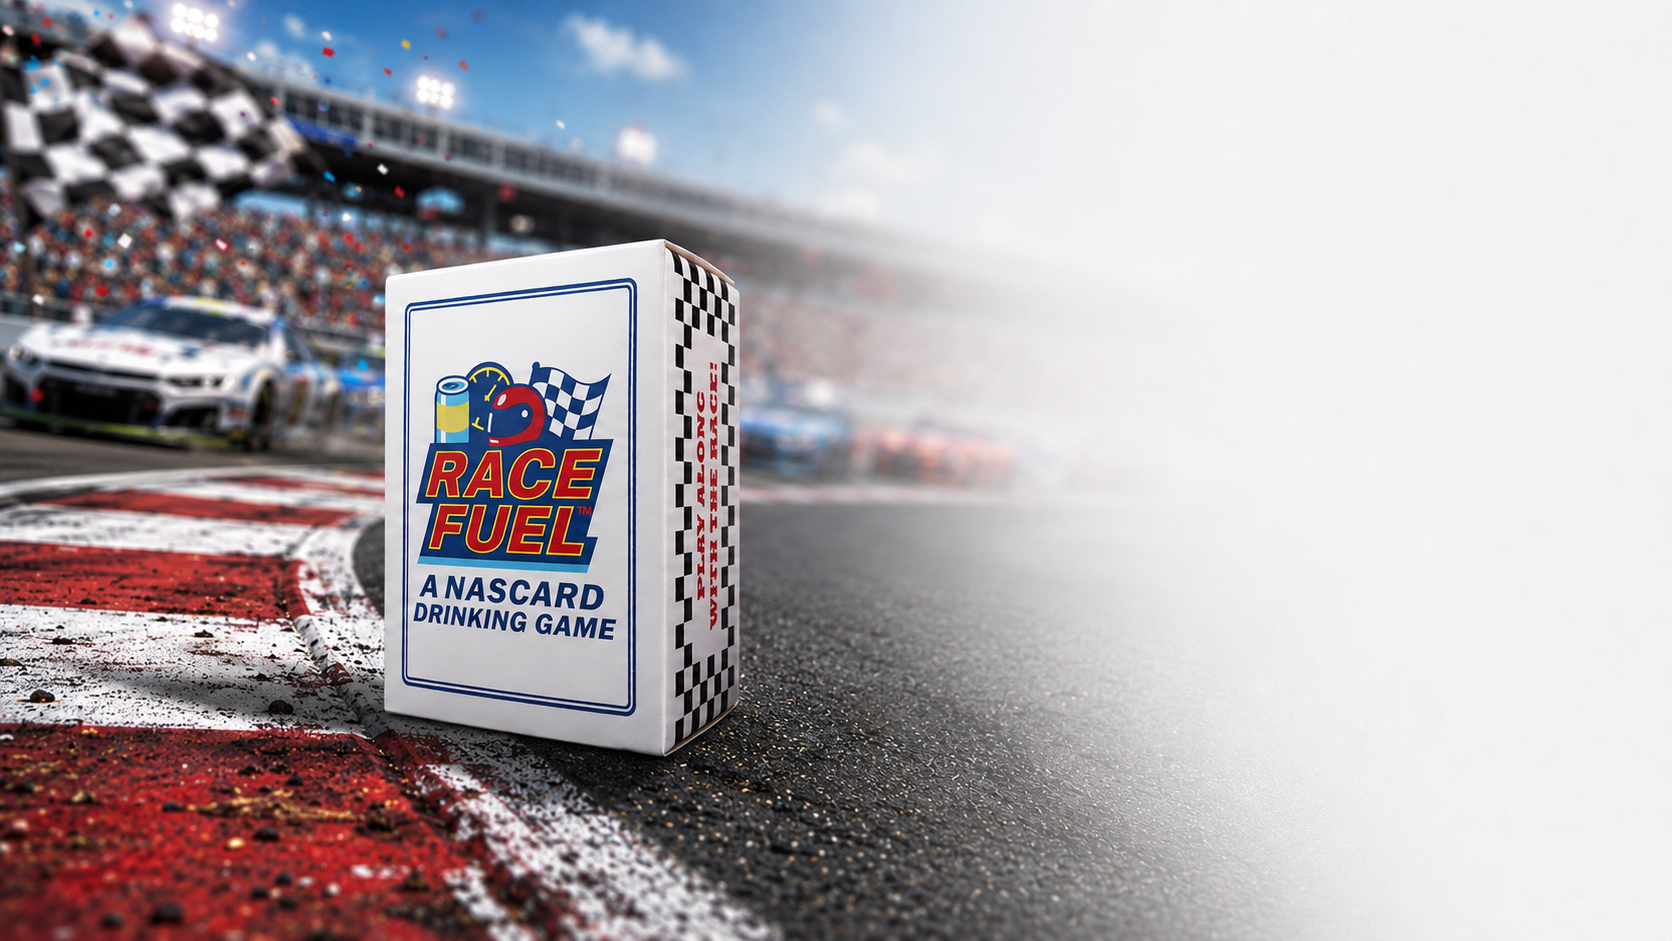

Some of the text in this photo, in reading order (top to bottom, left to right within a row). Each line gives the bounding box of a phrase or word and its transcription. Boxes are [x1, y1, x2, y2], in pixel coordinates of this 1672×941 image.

[425, 447, 603, 500] RACE
[696, 390, 706, 507] ALONG
[709, 468, 718, 534] THE
[428, 503, 585, 557] FUEL
[419, 574, 604, 611] A NASCARD
[709, 539, 718, 630] WITH
[413, 602, 617, 641] DRINKING GAME
